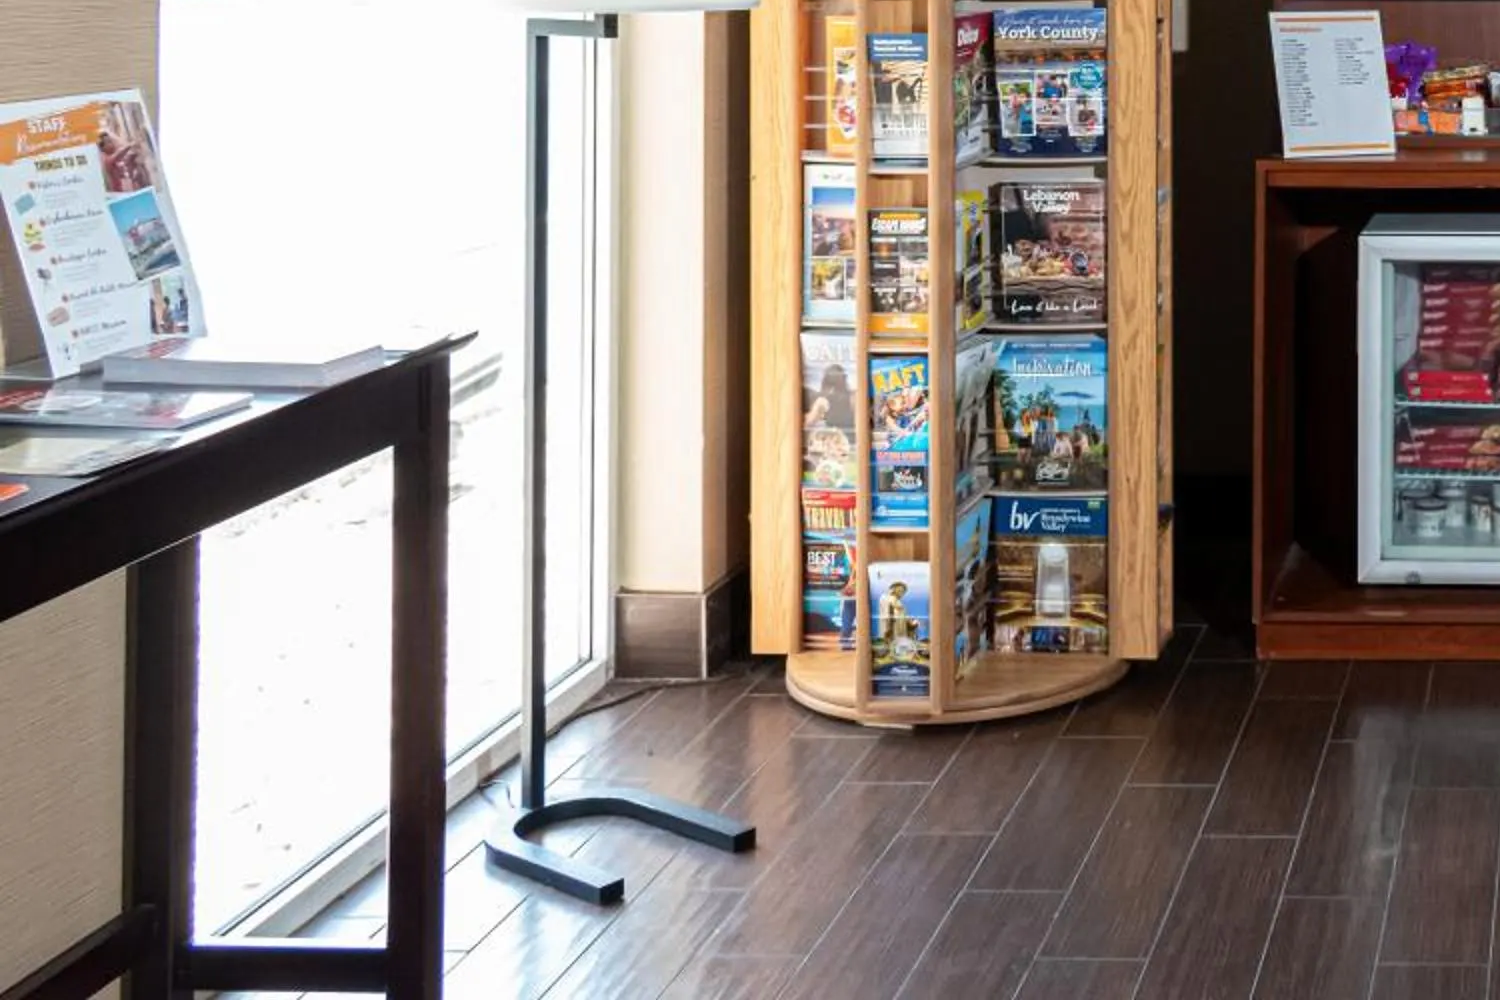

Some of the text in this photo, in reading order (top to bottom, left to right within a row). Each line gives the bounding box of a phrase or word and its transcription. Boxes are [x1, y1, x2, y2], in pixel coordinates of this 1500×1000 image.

[999, 25, 1099, 41] York County
[27, 118, 67, 134] STAFF
[1023, 189, 1080, 201] Lebanon
[1032, 201, 1072, 214] Valley
[871, 362, 926, 395] RAFT
[1009, 500, 1040, 531] bv
[807, 551, 838, 566] BEST
